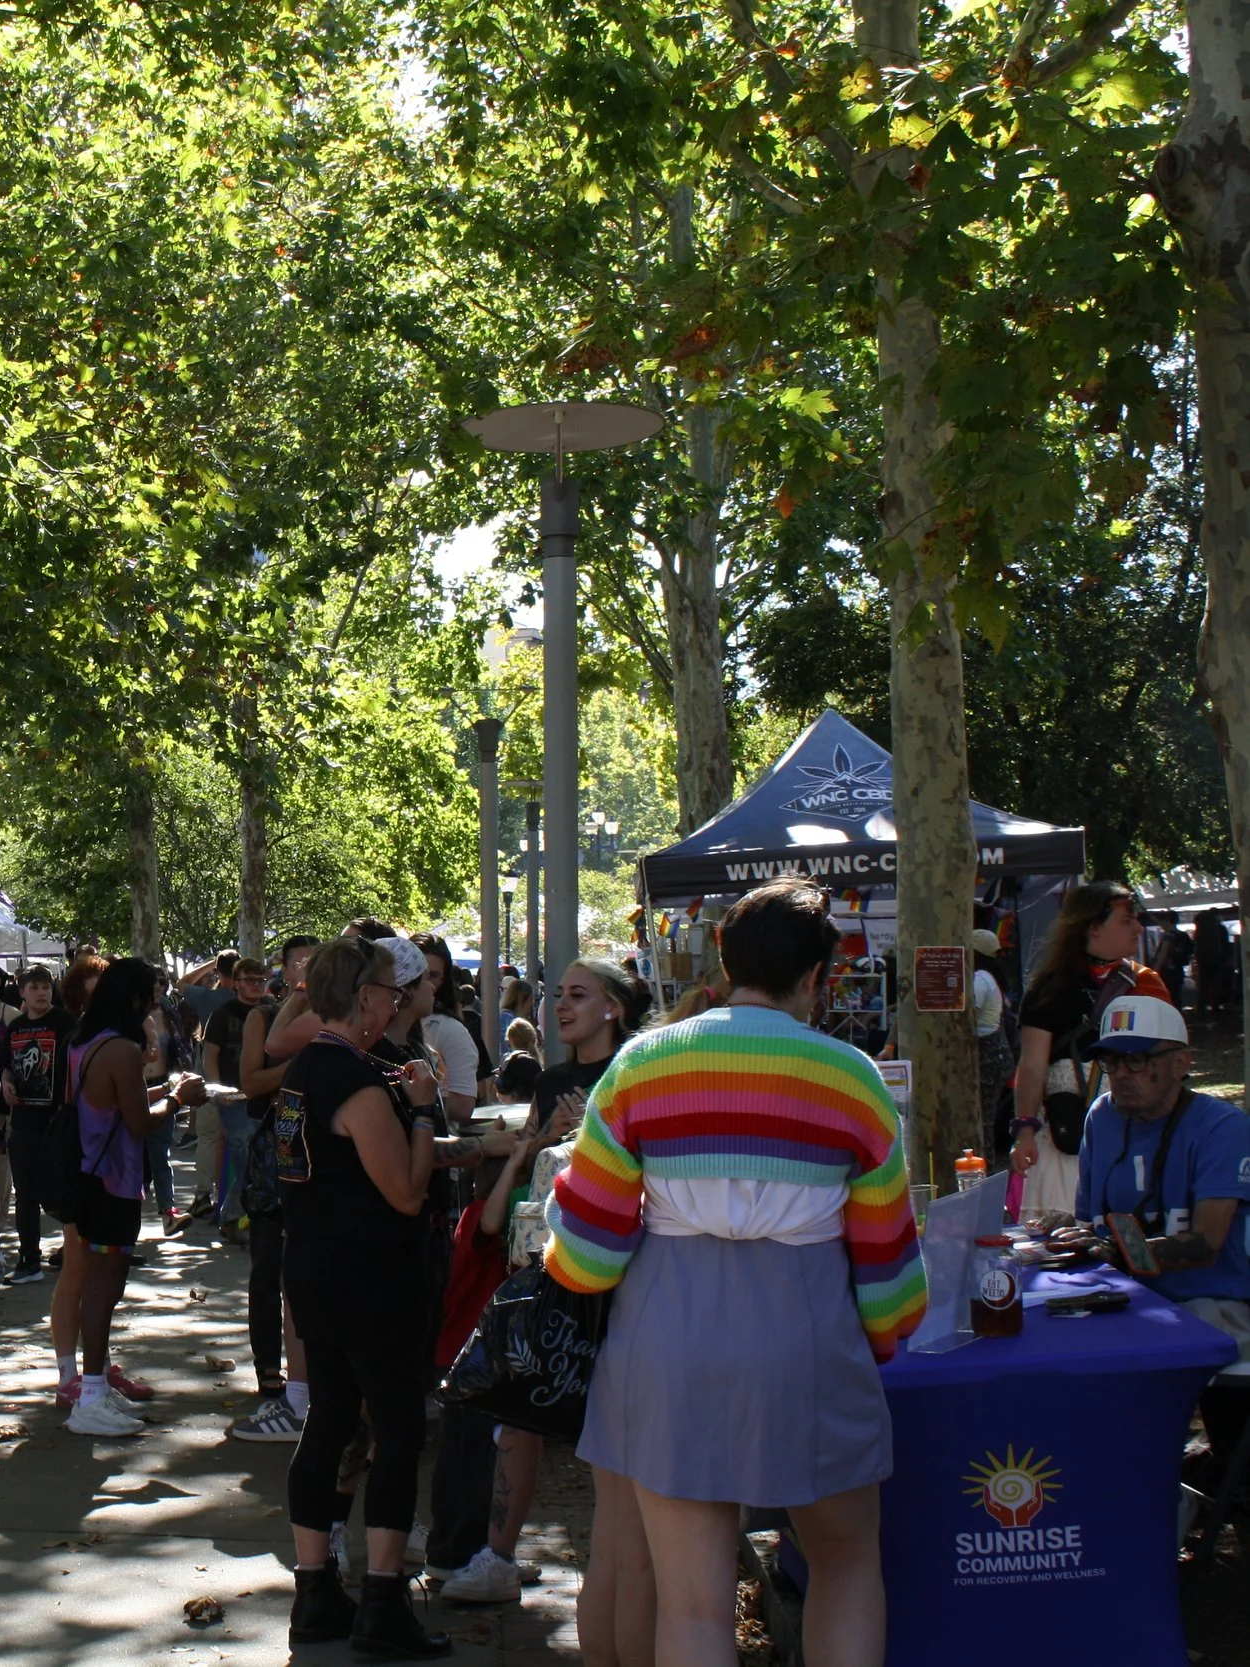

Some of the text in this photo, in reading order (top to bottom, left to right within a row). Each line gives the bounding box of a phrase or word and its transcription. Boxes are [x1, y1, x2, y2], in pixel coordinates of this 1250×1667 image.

[801, 789, 849, 809] WNC
[987, 1279, 1001, 1289] EAT
[955, 1525, 1082, 1555] SUNRISE
[956, 1551, 1083, 1574] COMMUNITY
[953, 1567, 1107, 1586] FOR RECOVERY AND WELLNESS
